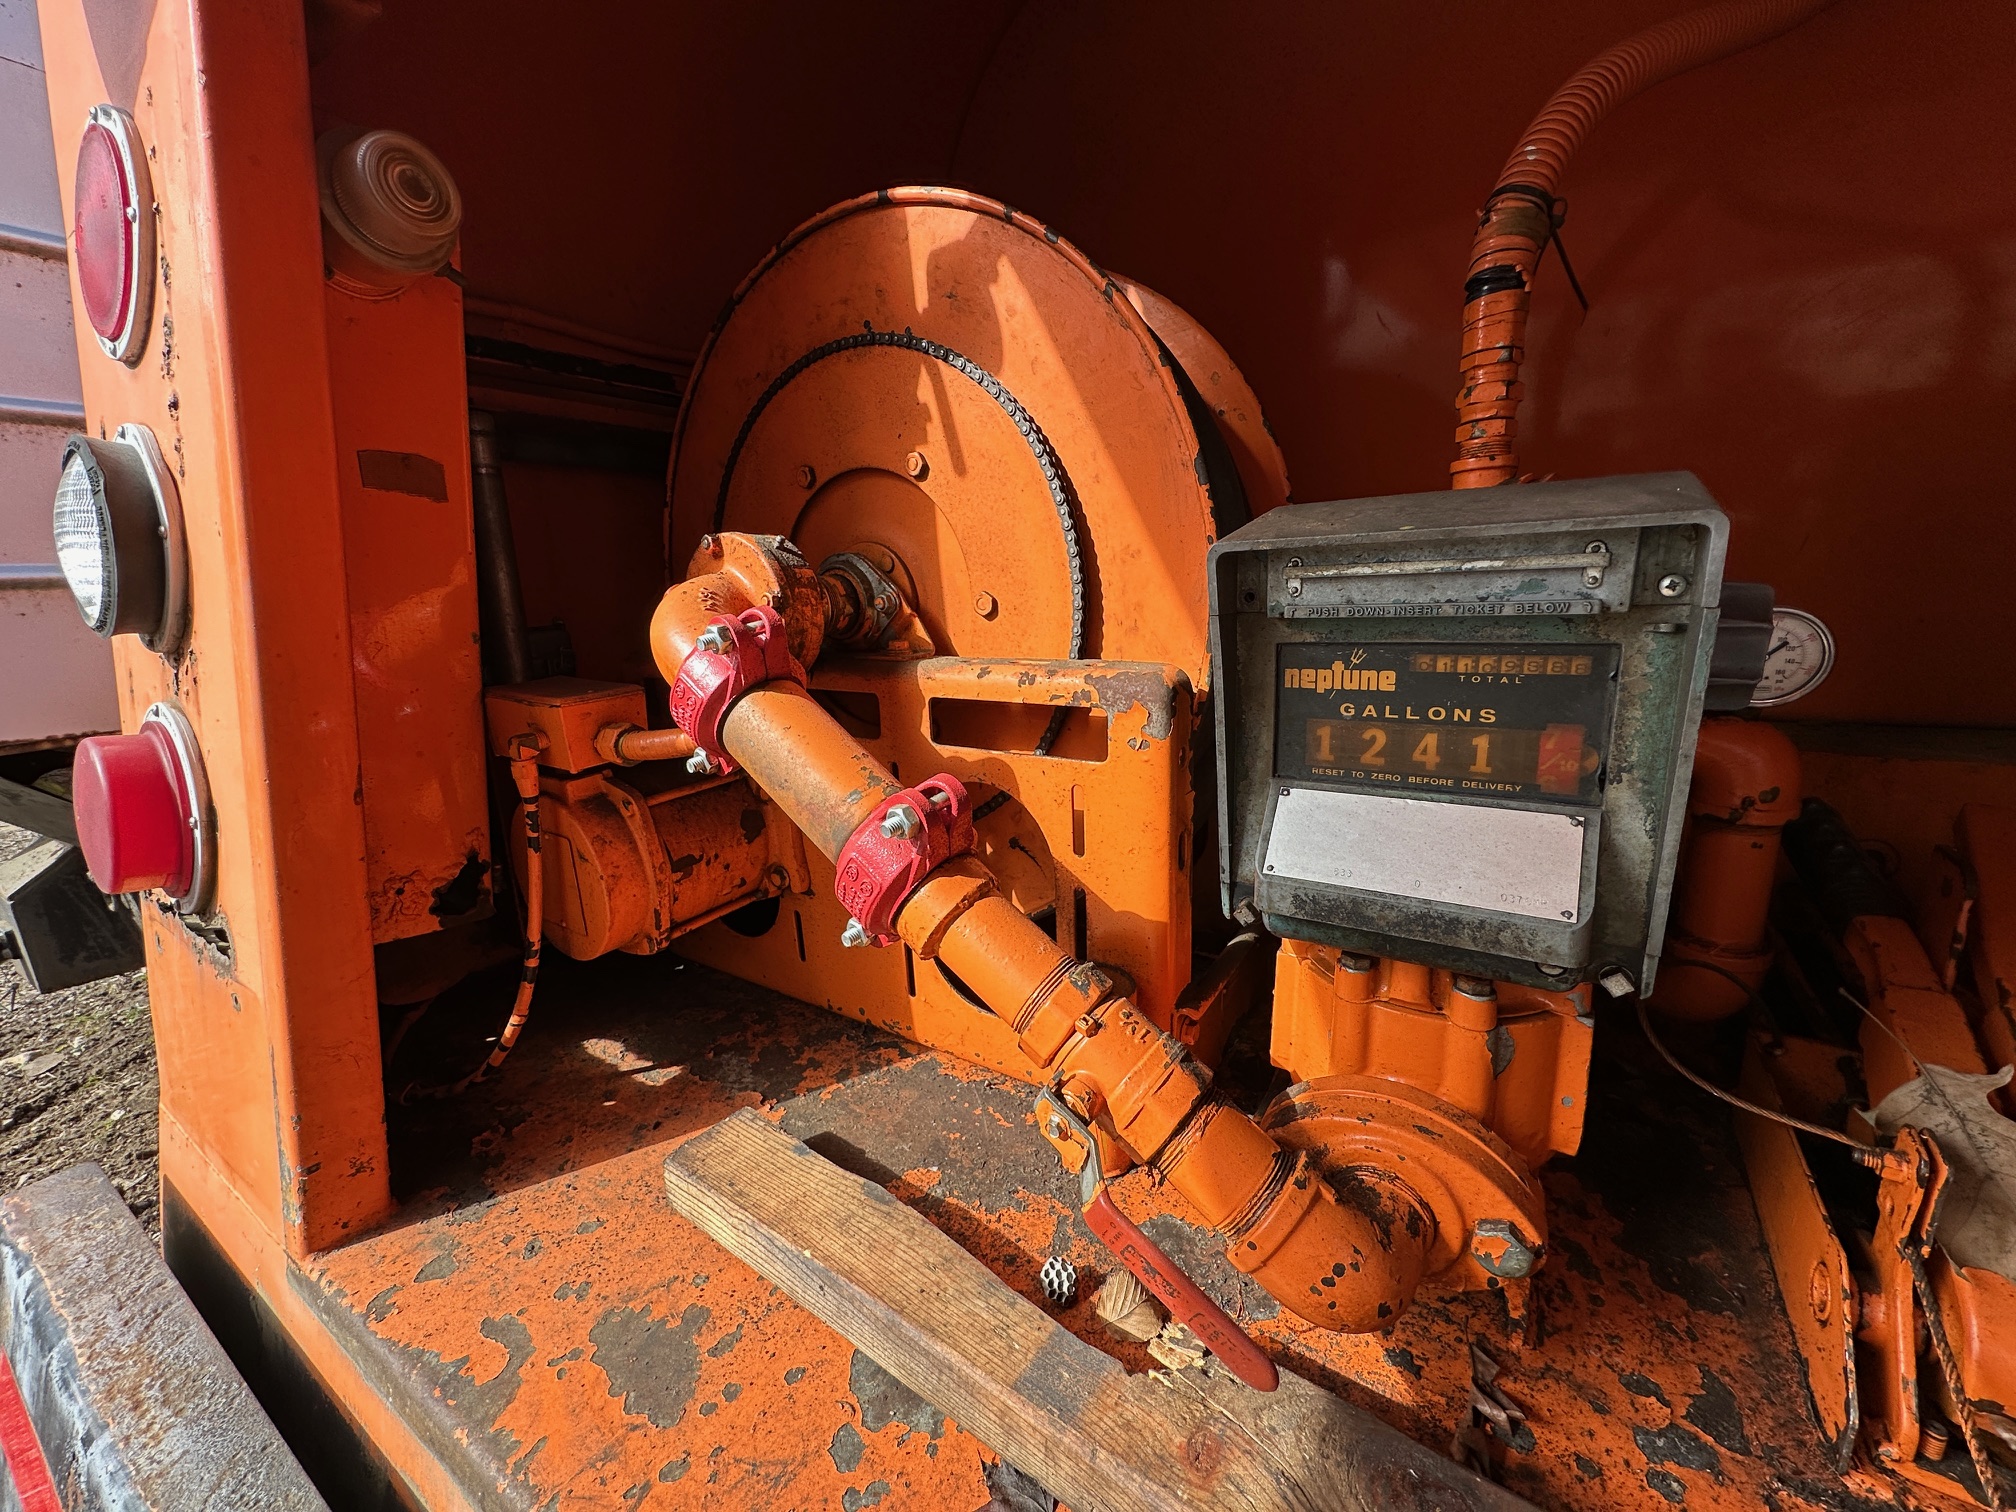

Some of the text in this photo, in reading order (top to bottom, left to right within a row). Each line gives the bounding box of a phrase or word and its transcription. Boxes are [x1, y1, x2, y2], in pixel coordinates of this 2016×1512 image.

[1307, 607, 1340, 617] PUSH
[1452, 604, 1505, 615] TICKET
[1514, 602, 1571, 614] BELOW
[1284, 660, 1396, 693] neptune
[1459, 675, 1522, 684] TOTAL
[1340, 702, 1496, 723] GALLONS
[1312, 767, 1522, 792] RESET TO ZERO BEFORE DELIVERY
